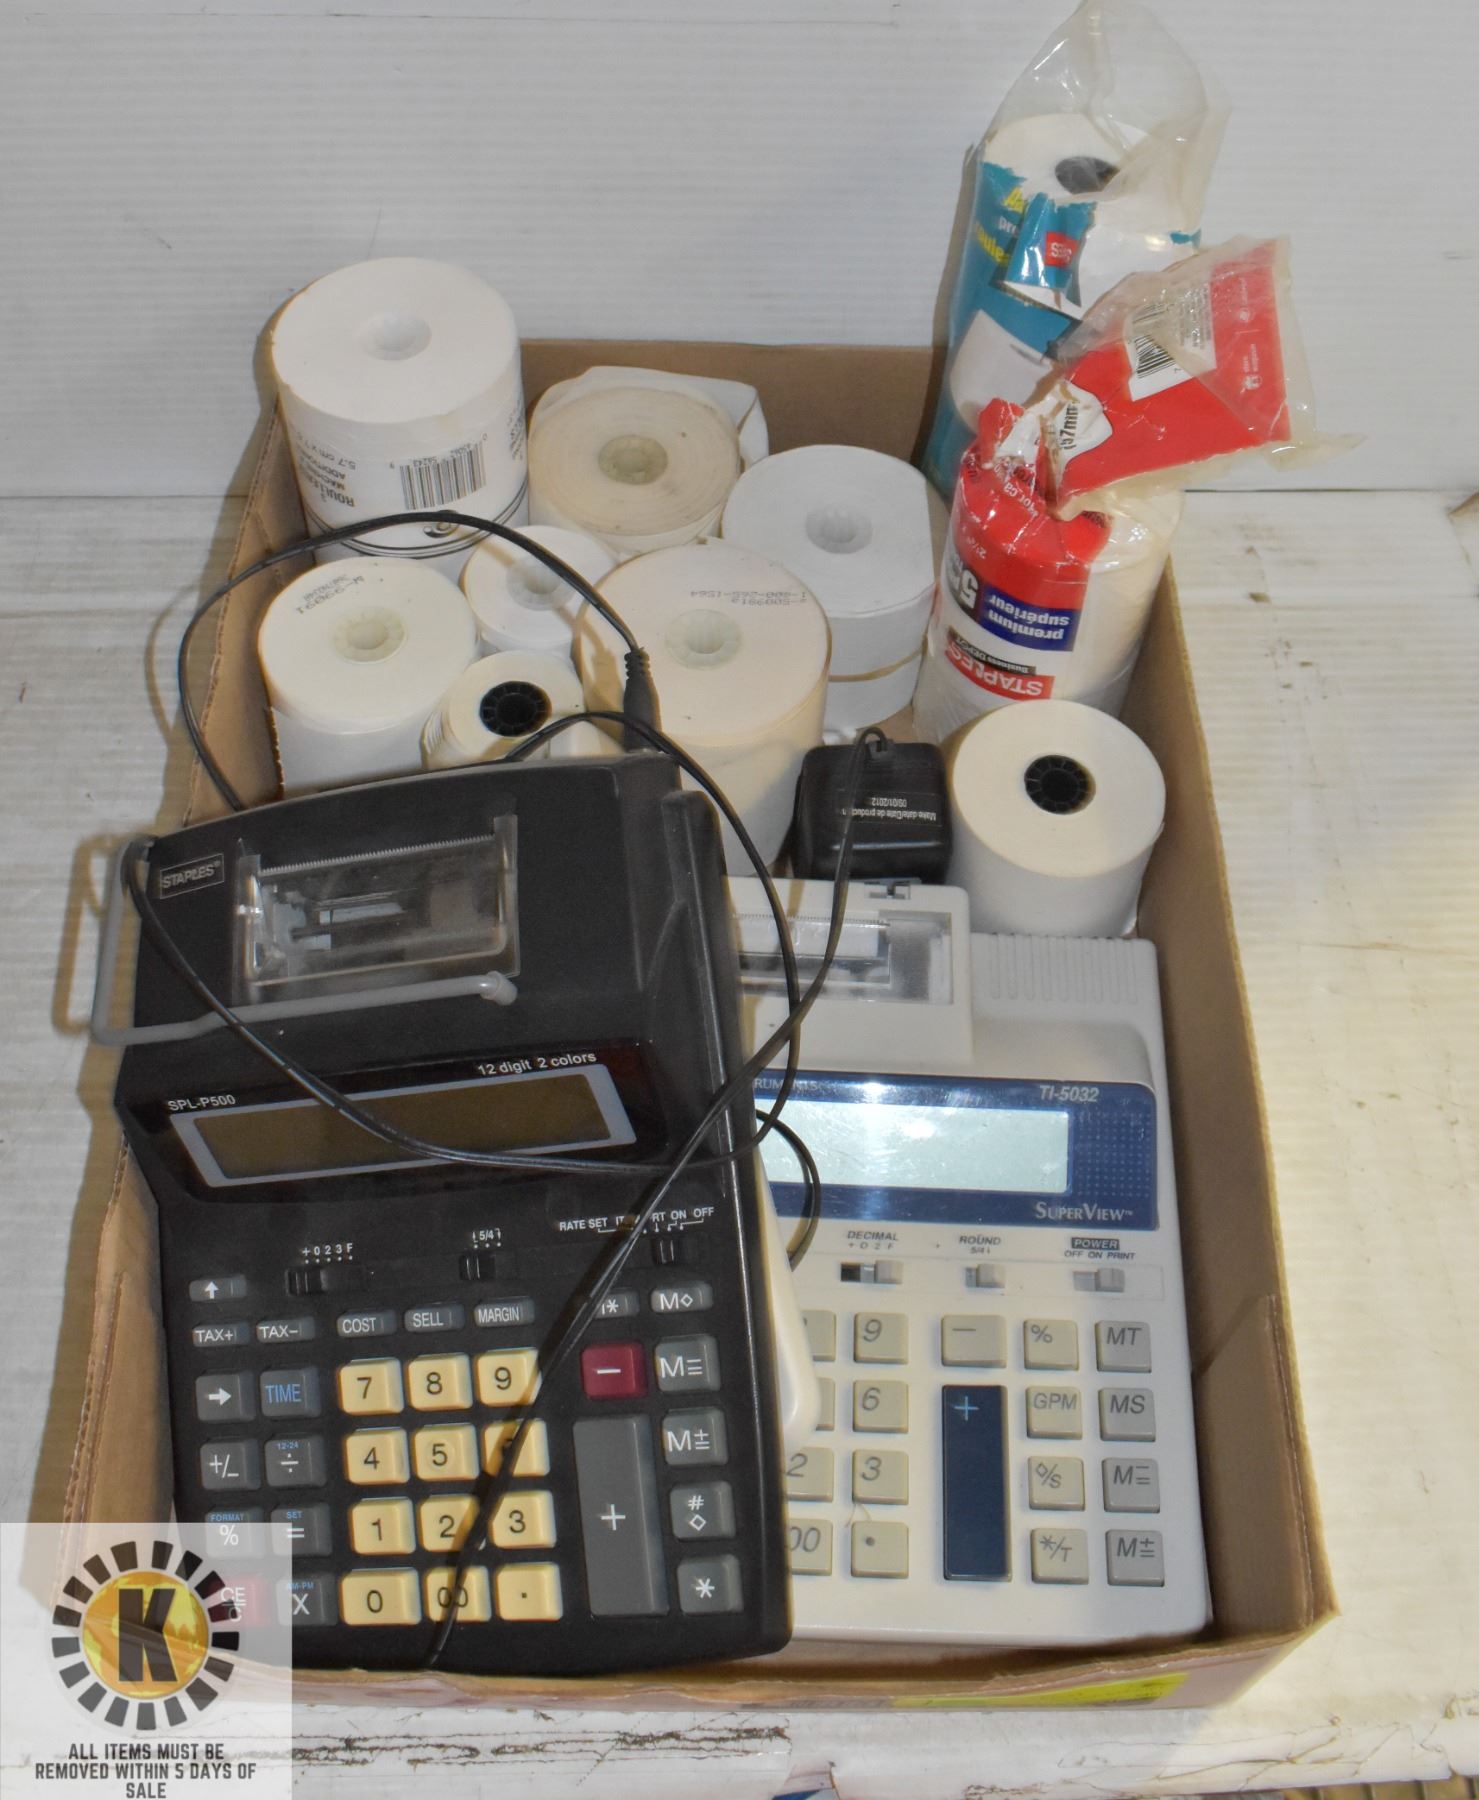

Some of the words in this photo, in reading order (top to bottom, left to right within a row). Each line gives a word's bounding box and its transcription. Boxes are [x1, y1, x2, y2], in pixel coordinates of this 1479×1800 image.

[989, 595, 1070, 626] supérieur
[988, 610, 1064, 640] premium
[947, 642, 1044, 696] STAPLES
[162, 863, 216, 889] STAPLES
[478, 1064, 497, 1075] 12
[500, 1059, 532, 1074] digit
[537, 1057, 548, 1068] 2
[551, 1053, 597, 1067] colors
[168, 1094, 236, 1111] SPL-P500
[1040, 1085, 1100, 1102] TI-5032
[559, 1219, 586, 1231] RATE
[589, 1217, 608, 1229] SET
[670, 1209, 687, 1220] ON
[693, 1206, 715, 1218] OFF
[847, 1230, 899, 1241] DECIMAL
[959, 1235, 1001, 1246] ROUND
[1073, 1239, 1119, 1250] POWER
[1064, 1250, 1083, 1258] OFF
[1087, 1251, 1102, 1259] ON
[1107, 1252, 1136, 1260] PRINT
[343, 1317, 377, 1333] COST
[413, 1313, 444, 1328] SELL
[478, 1306, 520, 1323] MARGIN
[195, 1329, 234, 1343] TAX+
[863, 1319, 882, 1342] 9
[1030, 1324, 1053, 1344] %
[1106, 1327, 1142, 1345] MT
[357, 1377, 372, 1399] 7
[426, 1372, 443, 1395] 8
[494, 1367, 512, 1390] 9
[265, 1384, 301, 1404] TIME
[862, 1388, 881, 1410] 6
[1033, 1393, 1078, 1411] GPM
[1109, 1394, 1145, 1414] MS
[364, 1447, 380, 1470] 4
[432, 1443, 448, 1466] 5
[785, 1453, 808, 1477] 2
[861, 1457, 882, 1481] 3
[210, 1513, 244, 1522] FORMAT
[286, 1511, 303, 1520] SET
[439, 1515, 456, 1538] 2
[509, 1510, 526, 1533] 3
[219, 1524, 239, 1546] %
[371, 1518, 383, 1541] 1
[366, 1590, 383, 1613] 0
